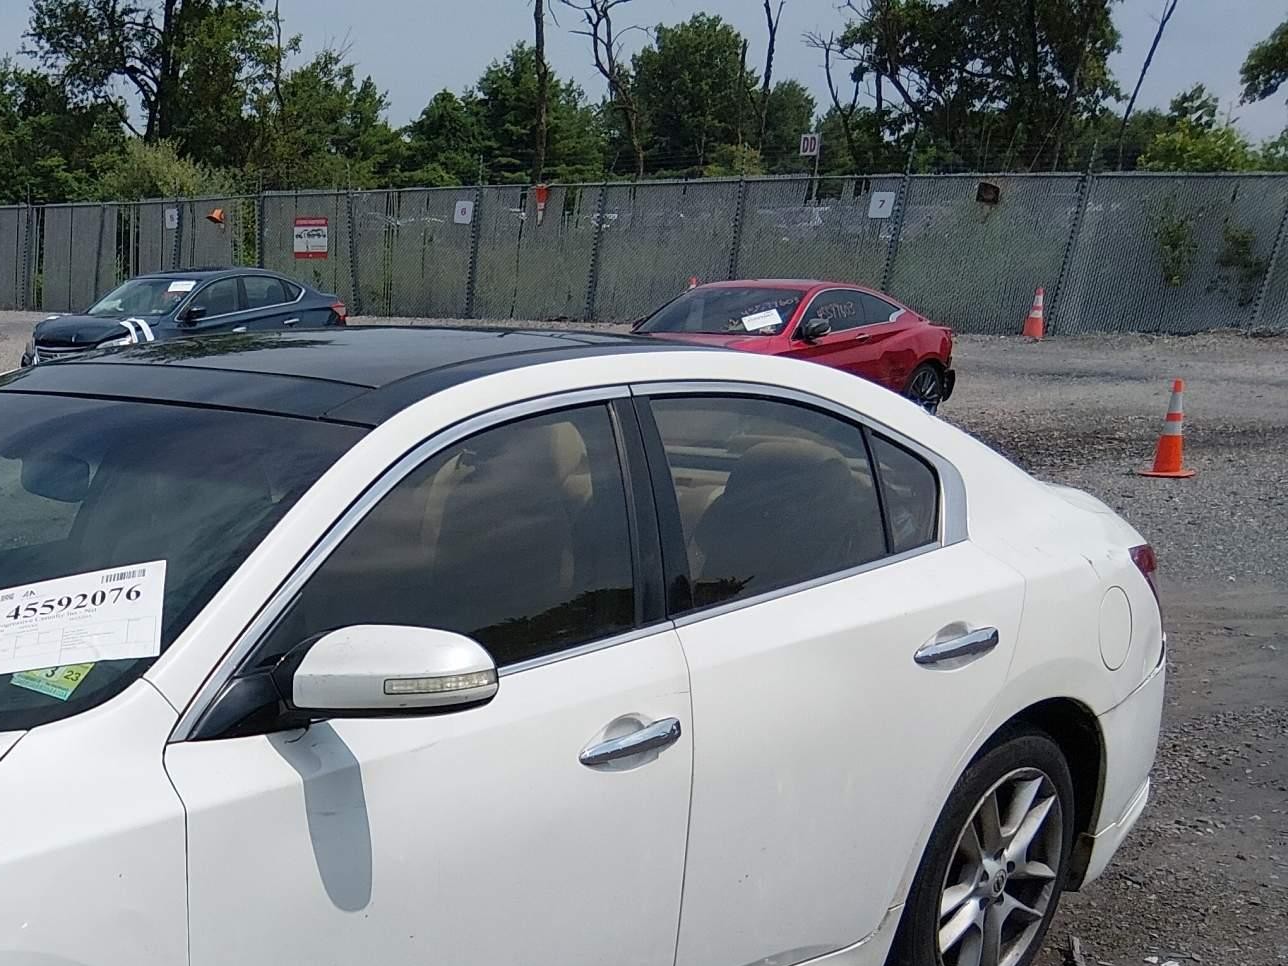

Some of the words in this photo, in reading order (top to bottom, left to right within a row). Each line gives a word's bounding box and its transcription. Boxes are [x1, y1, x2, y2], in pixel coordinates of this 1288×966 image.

[802, 136, 817, 154] DD
[877, 199, 886, 209] 7
[6, 583, 142, 621] 45592076
[64, 670, 81, 682] 23
